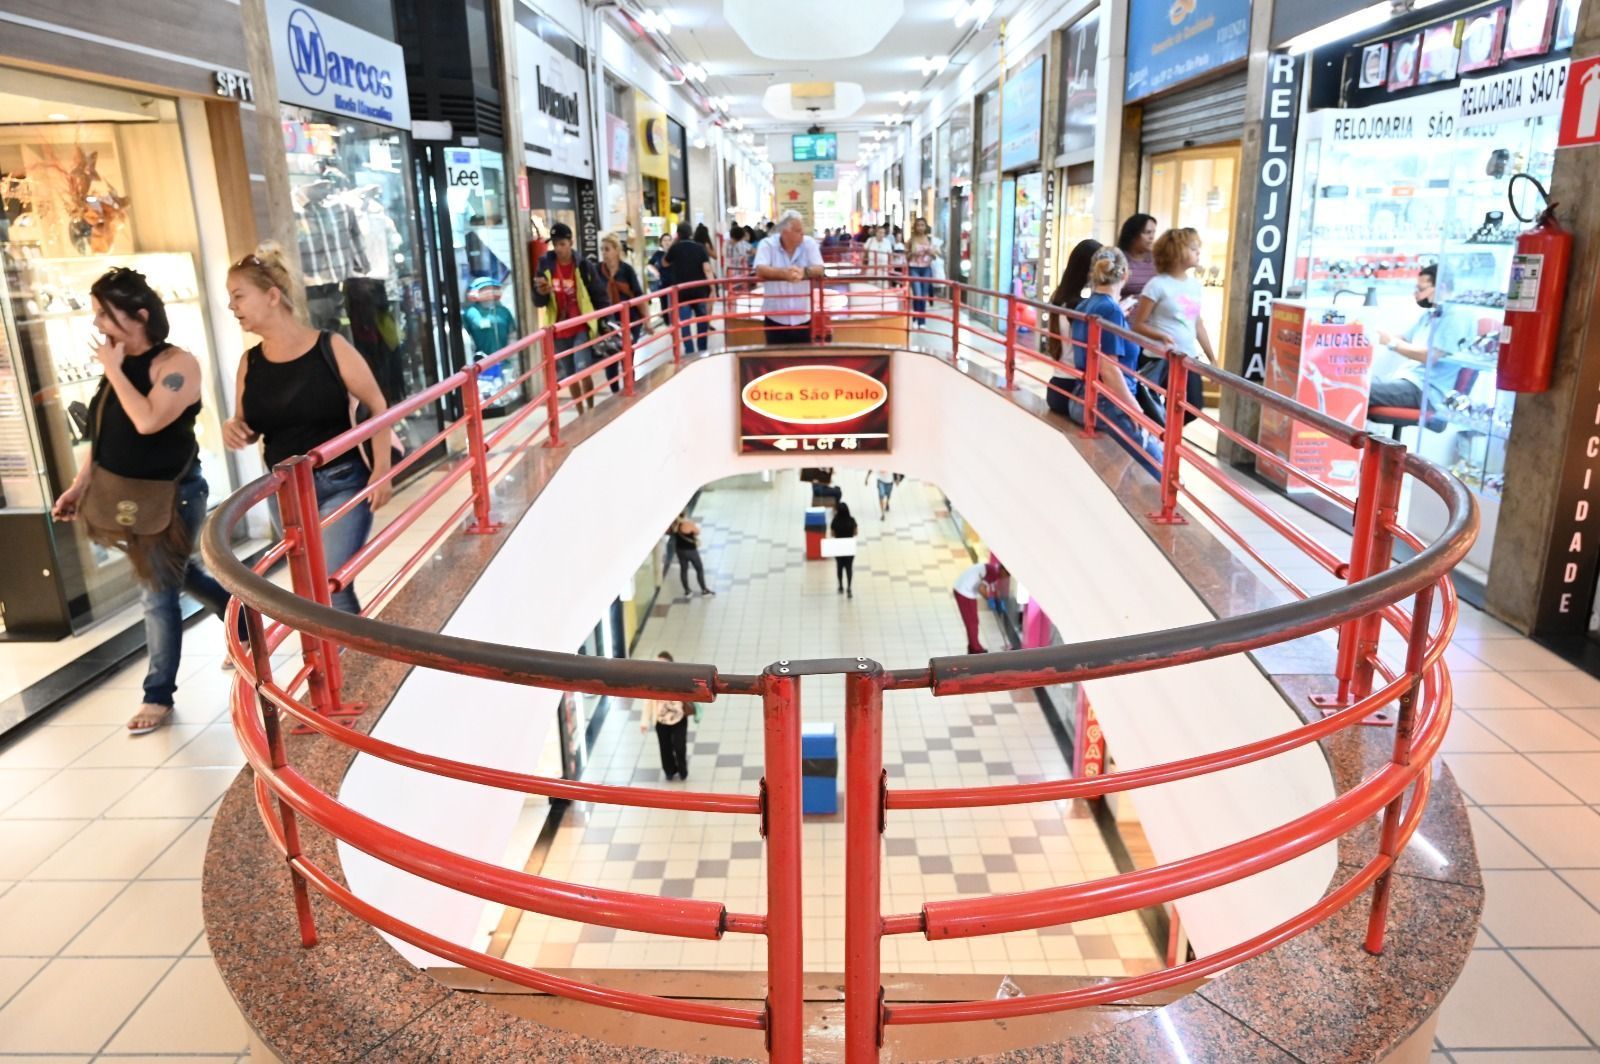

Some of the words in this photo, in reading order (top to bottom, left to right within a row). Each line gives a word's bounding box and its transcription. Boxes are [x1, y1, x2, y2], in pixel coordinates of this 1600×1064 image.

[289, 24, 393, 100] Marcos
[1459, 76, 1523, 118] RELOJOARIA
[1529, 64, 1555, 105] SÃO
[1556, 65, 1568, 100] P
[1333, 116, 1413, 141] RELOJOARIA
[1426, 111, 1454, 138] SÃO
[447, 167, 480, 186] Lee
[1245, 54, 1295, 378] RELOJOARIA
[1315, 333, 1370, 347] ALICATES
[799, 389, 830, 401] São
[834, 388, 880, 402] Paulo
[1559, 378, 1600, 613] CIDADE
